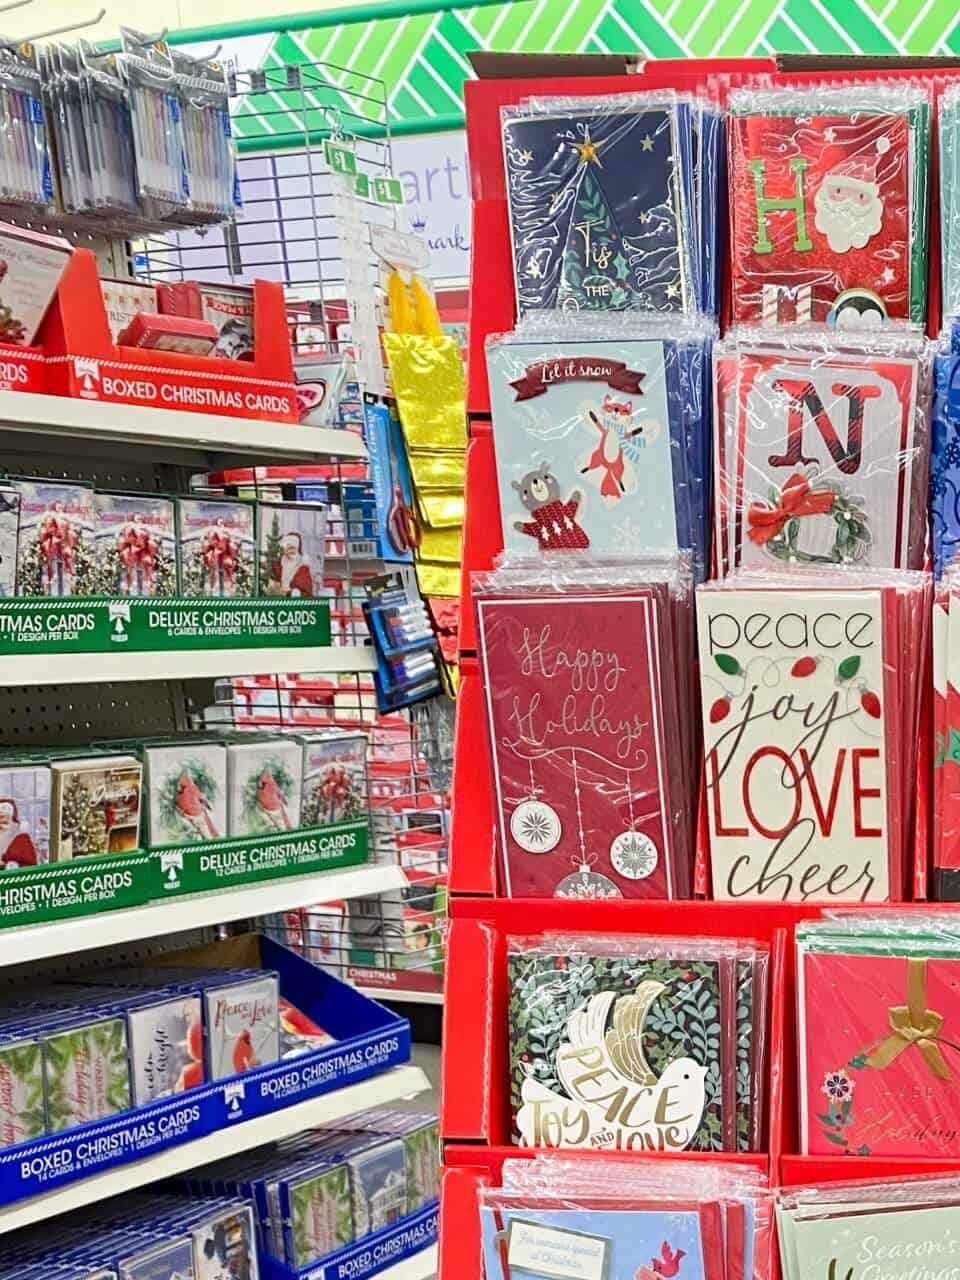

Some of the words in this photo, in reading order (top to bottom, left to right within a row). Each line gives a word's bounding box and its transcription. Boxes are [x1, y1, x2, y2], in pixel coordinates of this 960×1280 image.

[749, 158, 815, 254] H
[585, 285, 610, 297] THE
[541, 365, 562, 384] Let
[103, 377, 156, 401] BOXED
[160, 384, 243, 409] CHRISTMAS
[245, 393, 290, 414] CARDS
[17, 632, 47, 642] DESIGN
[49, 631, 62, 641] PER
[64, 631, 79, 641] BOX
[46, 614, 95, 632] CARDS
[149, 611, 199, 628] DELUXE
[202, 611, 277, 627] CHRISTMAS
[280, 610, 316, 626] CARDS
[205, 626, 241, 636] ENVELOPES
[708, 612, 874, 656] peace
[519, 624, 626, 691] Happy
[508, 692, 649, 759] Holidays
[704, 686, 862, 790] joy
[709, 745, 883, 840] LOVE
[200, 852, 247, 872] DELUXE
[249, 841, 317, 866] CHRISTMAS
[319, 832, 356, 854] CARDS
[727, 817, 889, 901] cheer
[81, 870, 132, 893] CARDS
[52, 892, 83, 908] DESIGN
[349, 968, 397, 982] CHRISTMAS
[260, 1071, 299, 1097] BOXED
[302, 1048, 363, 1082] CHRISTMAS
[364, 1037, 399, 1059] CARDS
[20, 1148, 73, 1180] BOXED
[76, 1122, 155, 1160] CHRISTMAS
[158, 1105, 201, 1132] CARDS
[590, 1132, 615, 1147] AND
[49, 1165, 74, 1179] CARDS
[83, 1147, 123, 1168] ENVELOPES
[338, 1253, 371, 1279] BOXED
[373, 1223, 425, 1259] CHRISTMAS
[856, 1231, 960, 1264] Season's
